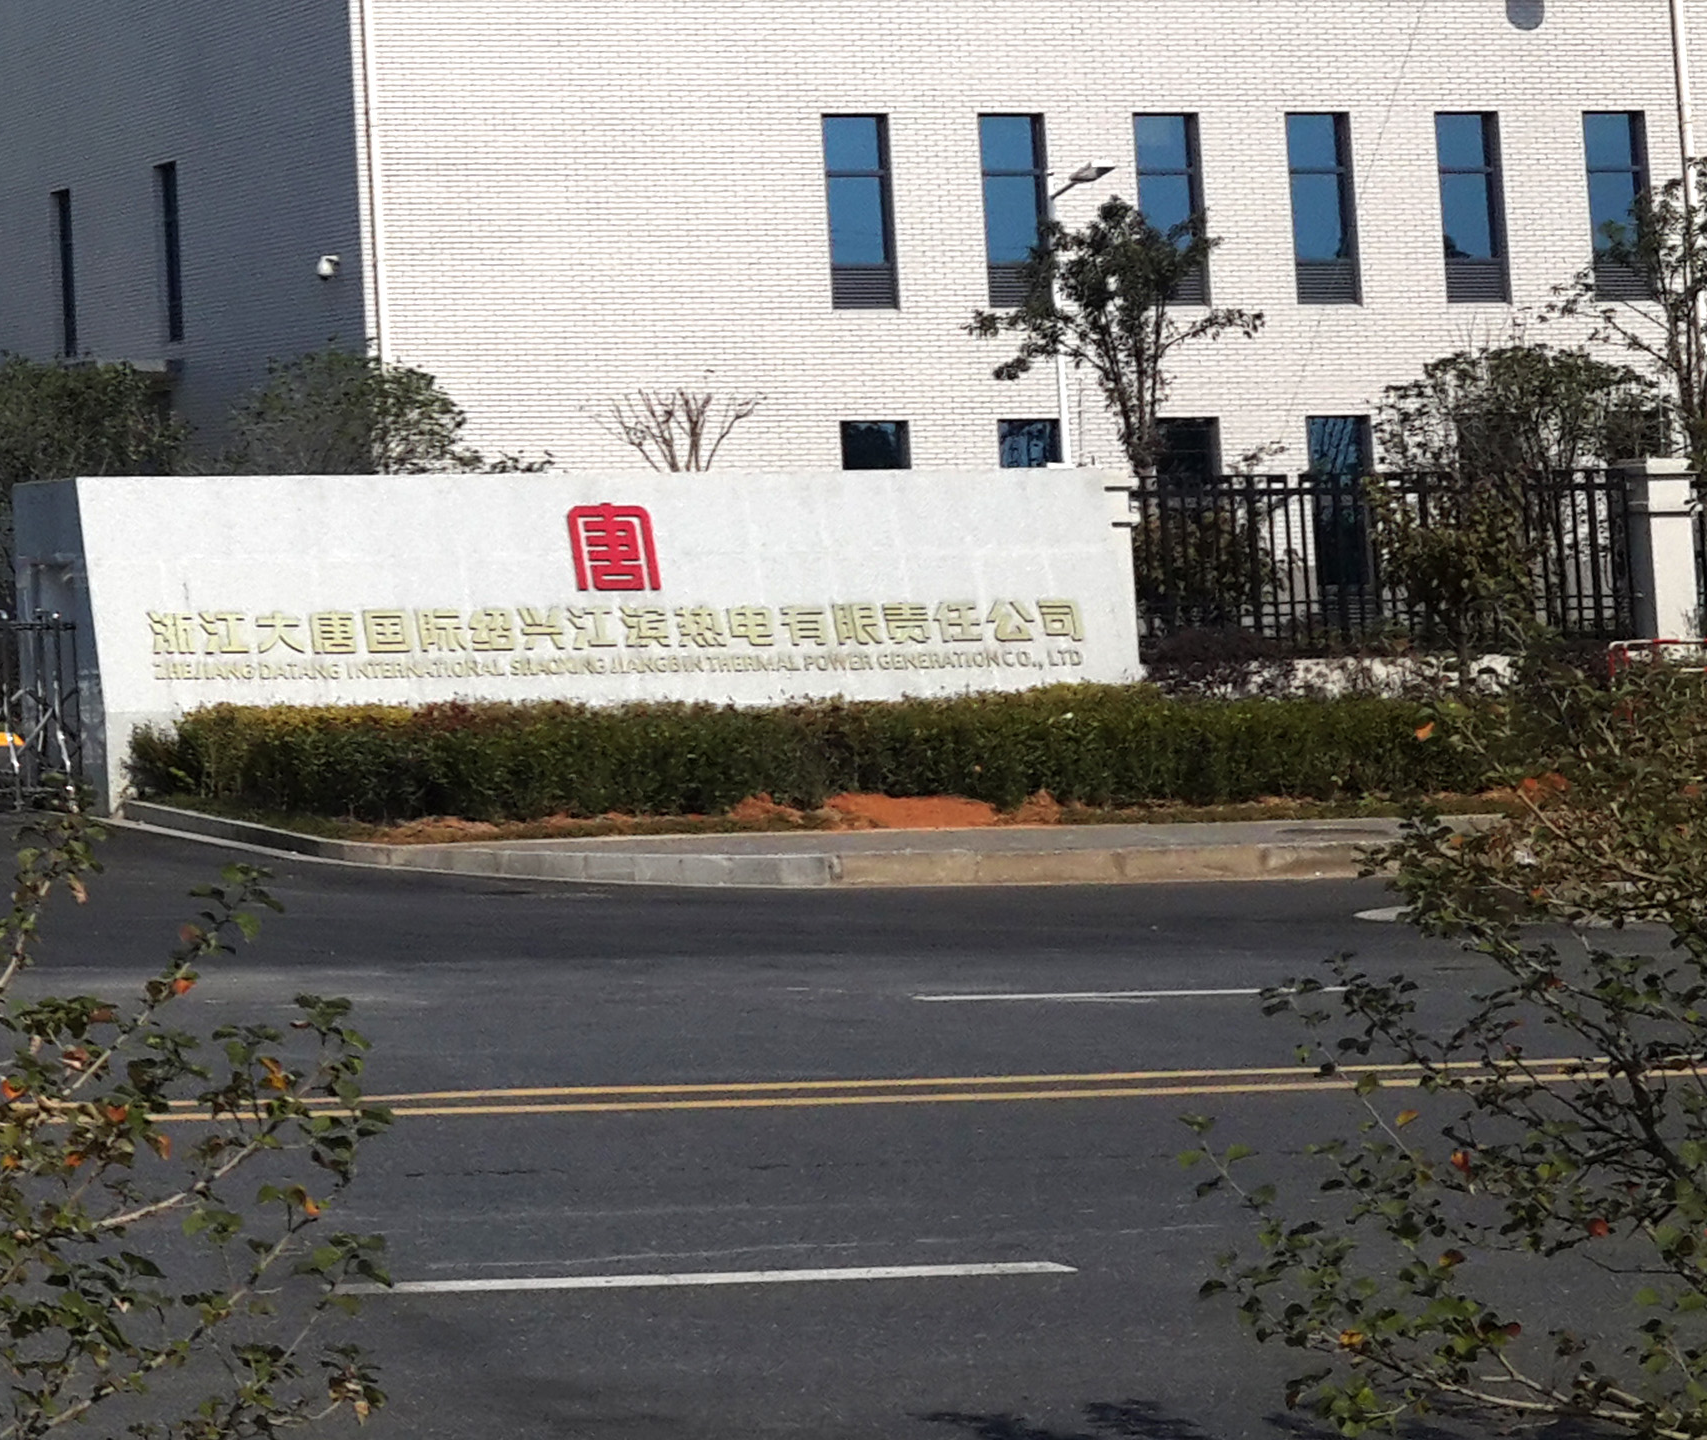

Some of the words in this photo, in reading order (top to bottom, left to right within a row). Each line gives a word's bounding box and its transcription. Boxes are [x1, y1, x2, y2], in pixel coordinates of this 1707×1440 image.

[144, 598, 1084, 655] 浙江大唐国际绍兴江滨热电有限责任公司
[152, 663, 256, 681] ZHEJIANG
[258, 662, 341, 680] DATANG
[345, 659, 506, 680] INTERNATIONAL
[705, 654, 801, 673] THERMAL
[803, 653, 874, 672] POWER
[877, 650, 1000, 671] GENERATION
[1046, 647, 1084, 667] LTD
